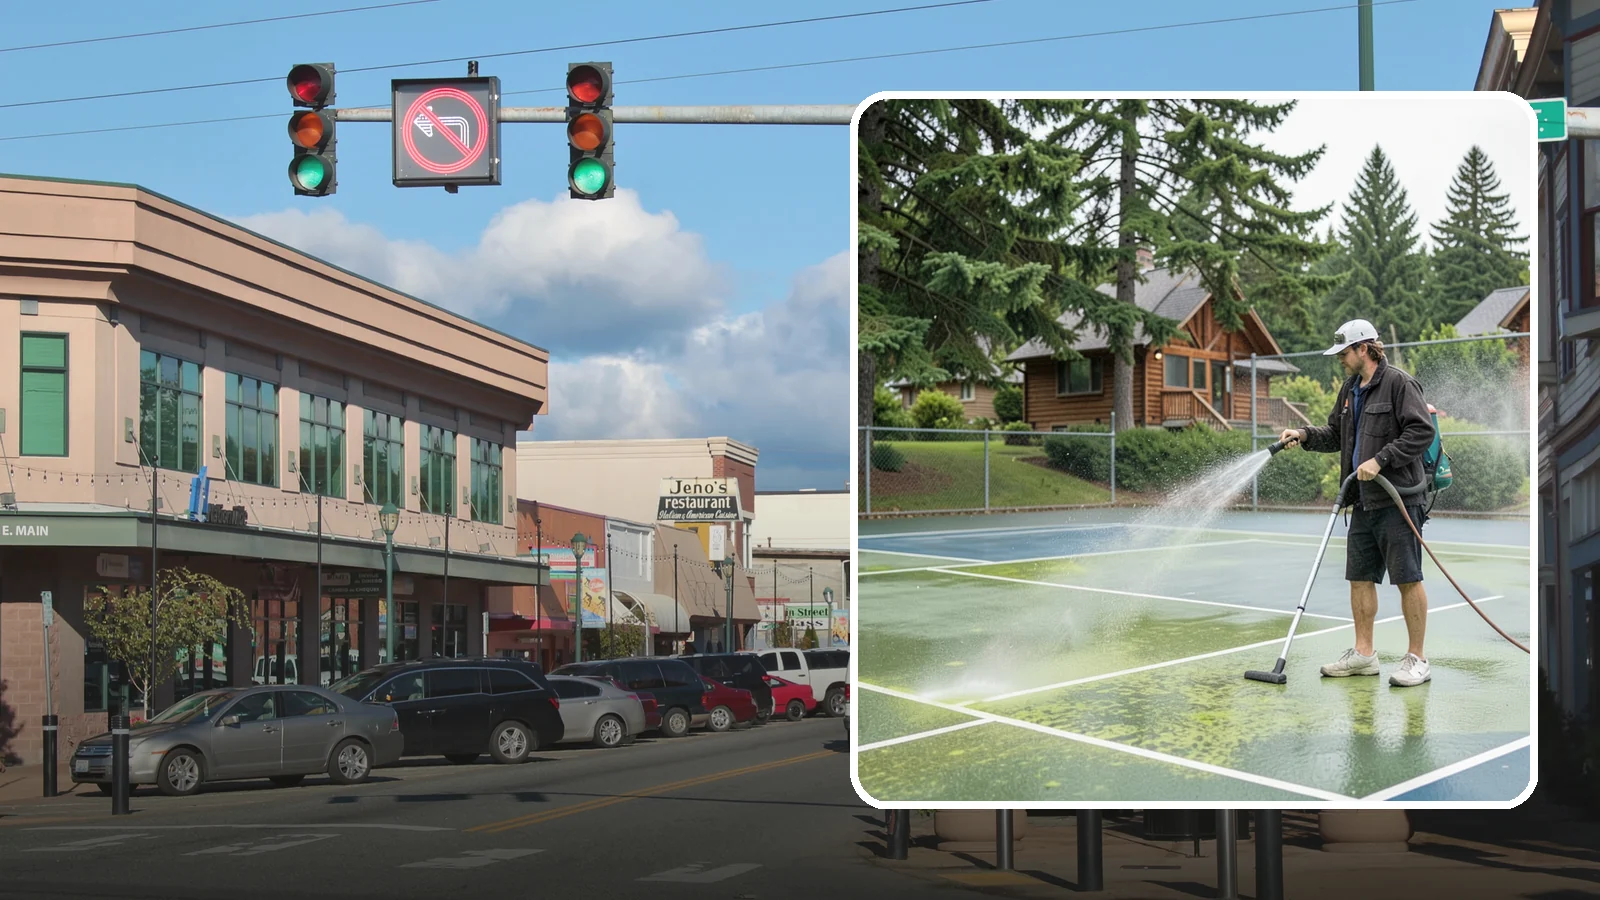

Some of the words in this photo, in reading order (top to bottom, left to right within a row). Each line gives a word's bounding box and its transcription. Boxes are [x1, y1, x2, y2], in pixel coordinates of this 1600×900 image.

[670, 480, 728, 495] Jeno's
[665, 497, 731, 509] restaurant
[659, 510, 682, 520] Italian
[686, 510, 715, 519] American
[715, 510, 738, 519] Cuisine
[2, 525, 13, 536] E.
[15, 525, 49, 536] MAIN
[797, 607, 829, 617] Street
[787, 619, 824, 627] lass
